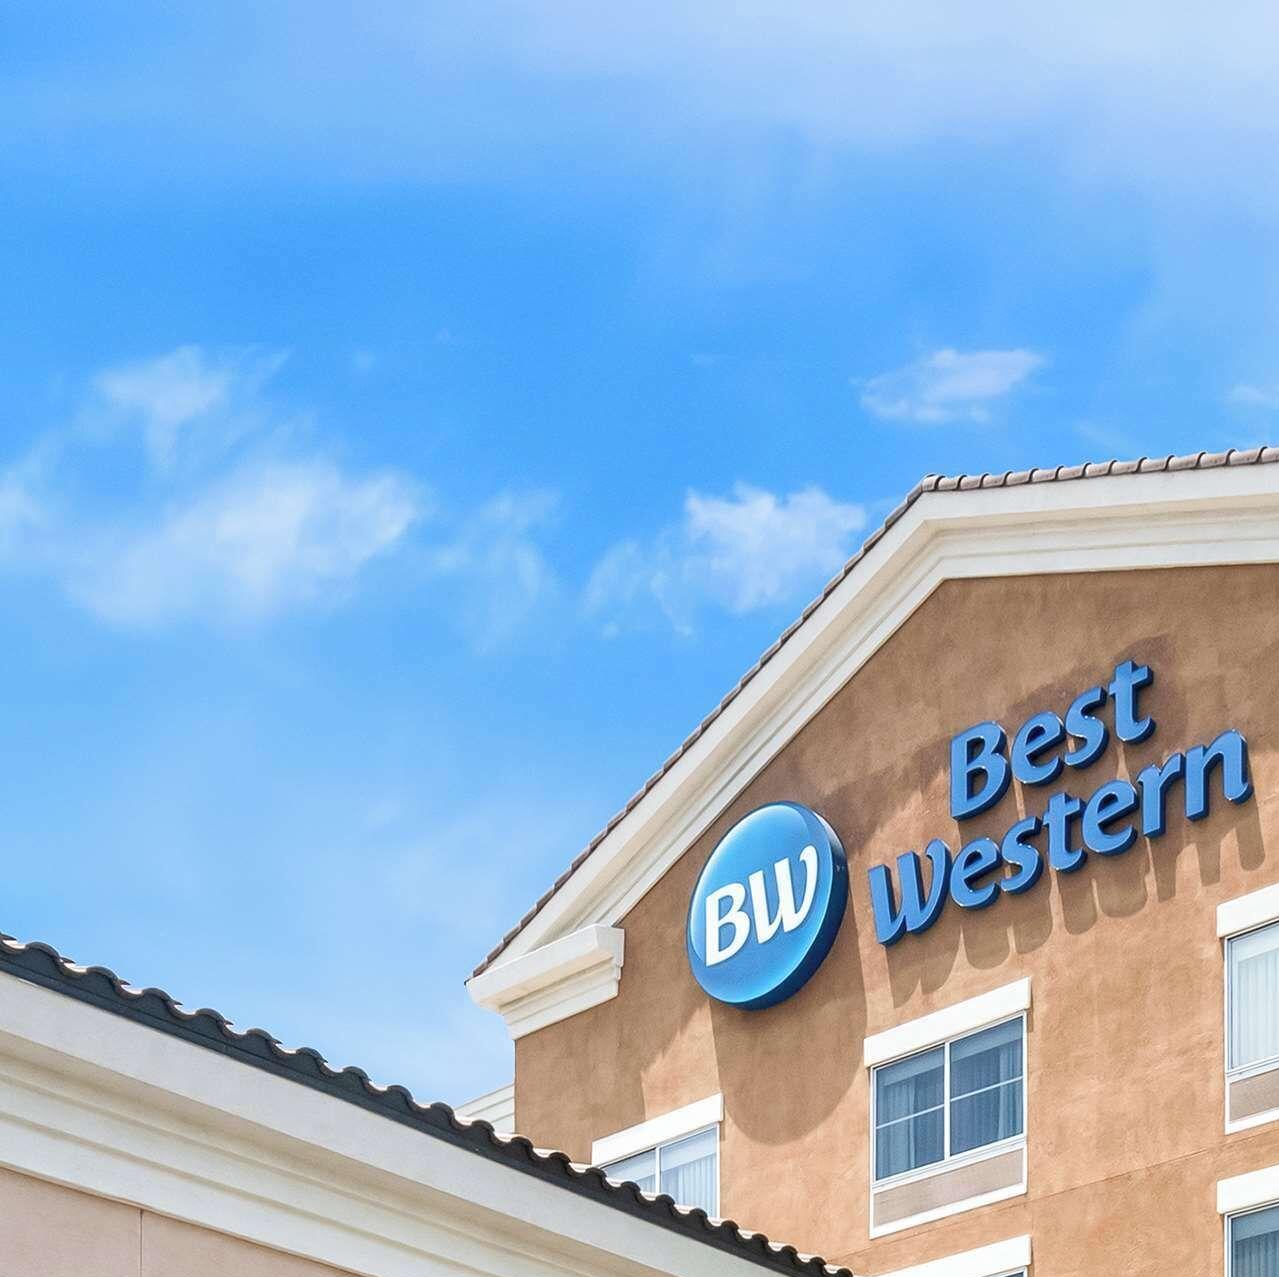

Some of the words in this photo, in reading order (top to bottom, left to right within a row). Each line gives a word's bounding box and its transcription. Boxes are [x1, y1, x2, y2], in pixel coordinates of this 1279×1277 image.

[949, 660, 1154, 820] Best
[704, 845, 818, 967] BW
[868, 728, 1255, 946] Western
